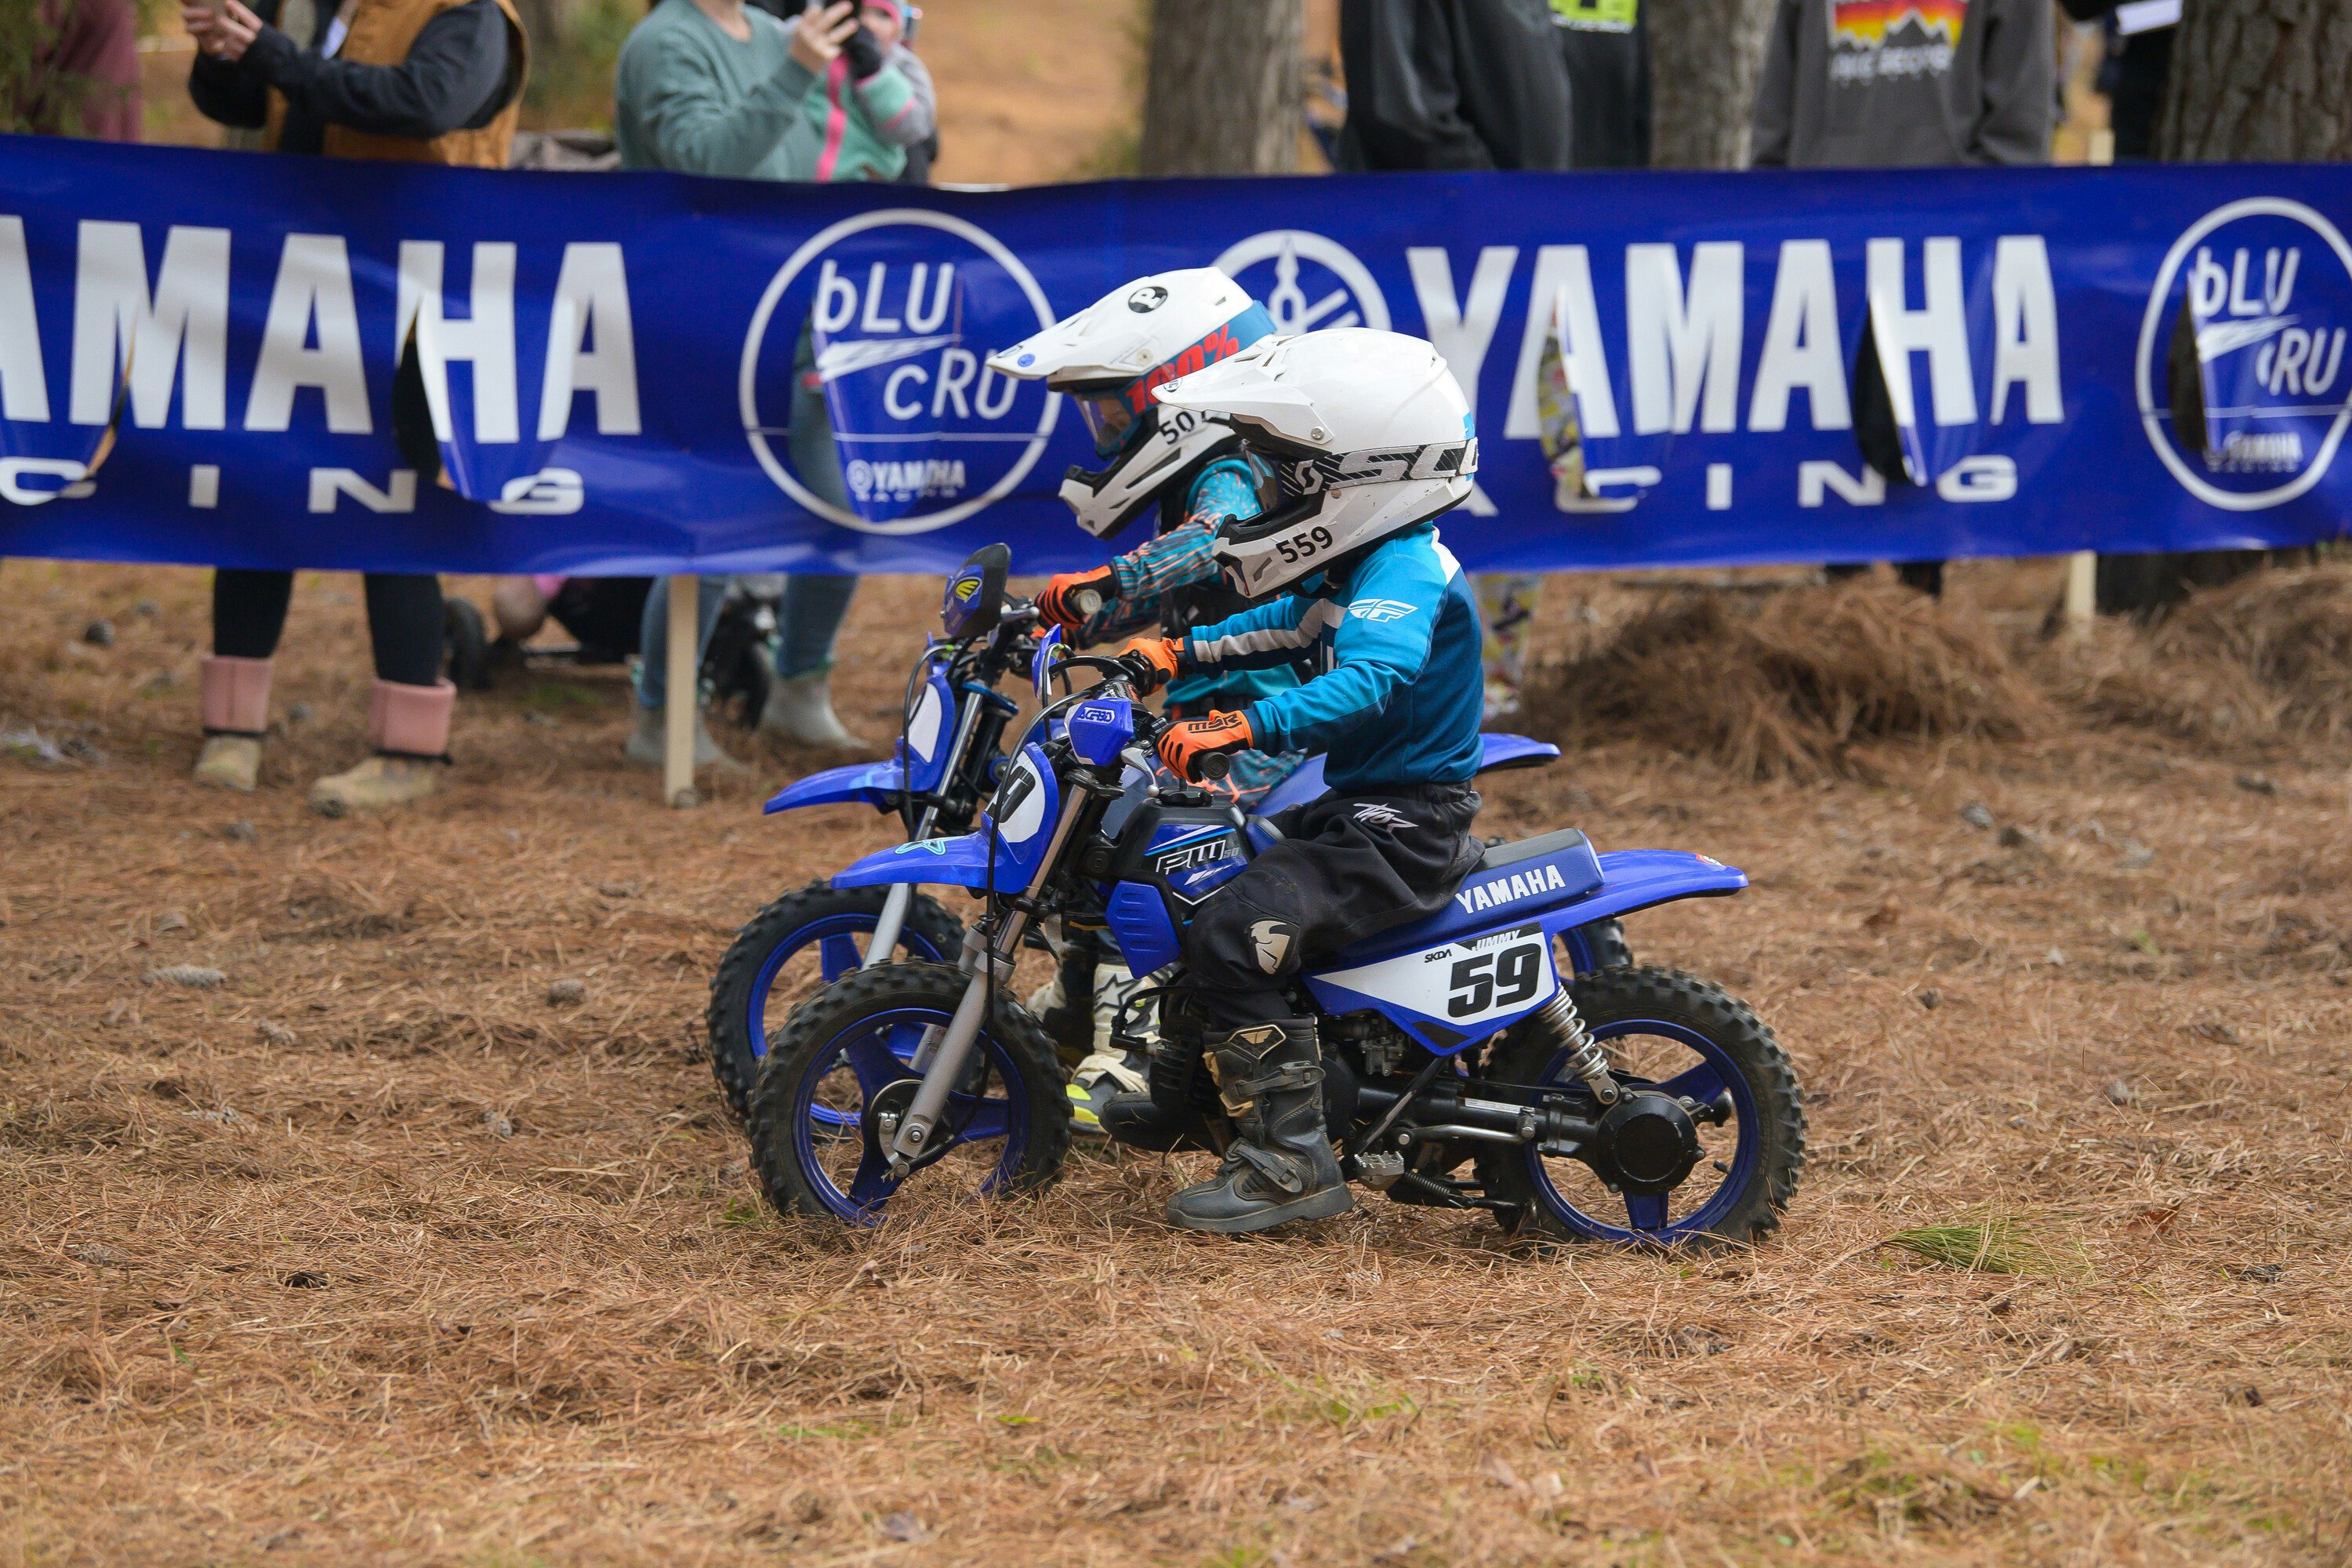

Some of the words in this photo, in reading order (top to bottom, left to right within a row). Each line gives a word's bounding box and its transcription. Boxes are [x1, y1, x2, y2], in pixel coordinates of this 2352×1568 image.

[1405, 235, 2064, 441] YAMAHA
[1276, 526, 1333, 564] 559
[1454, 864, 1566, 914] YAMAHA
[1424, 949, 1452, 964] SKDA
[1472, 929, 1521, 951] JIMMY
[1447, 942, 1541, 1018] 59
